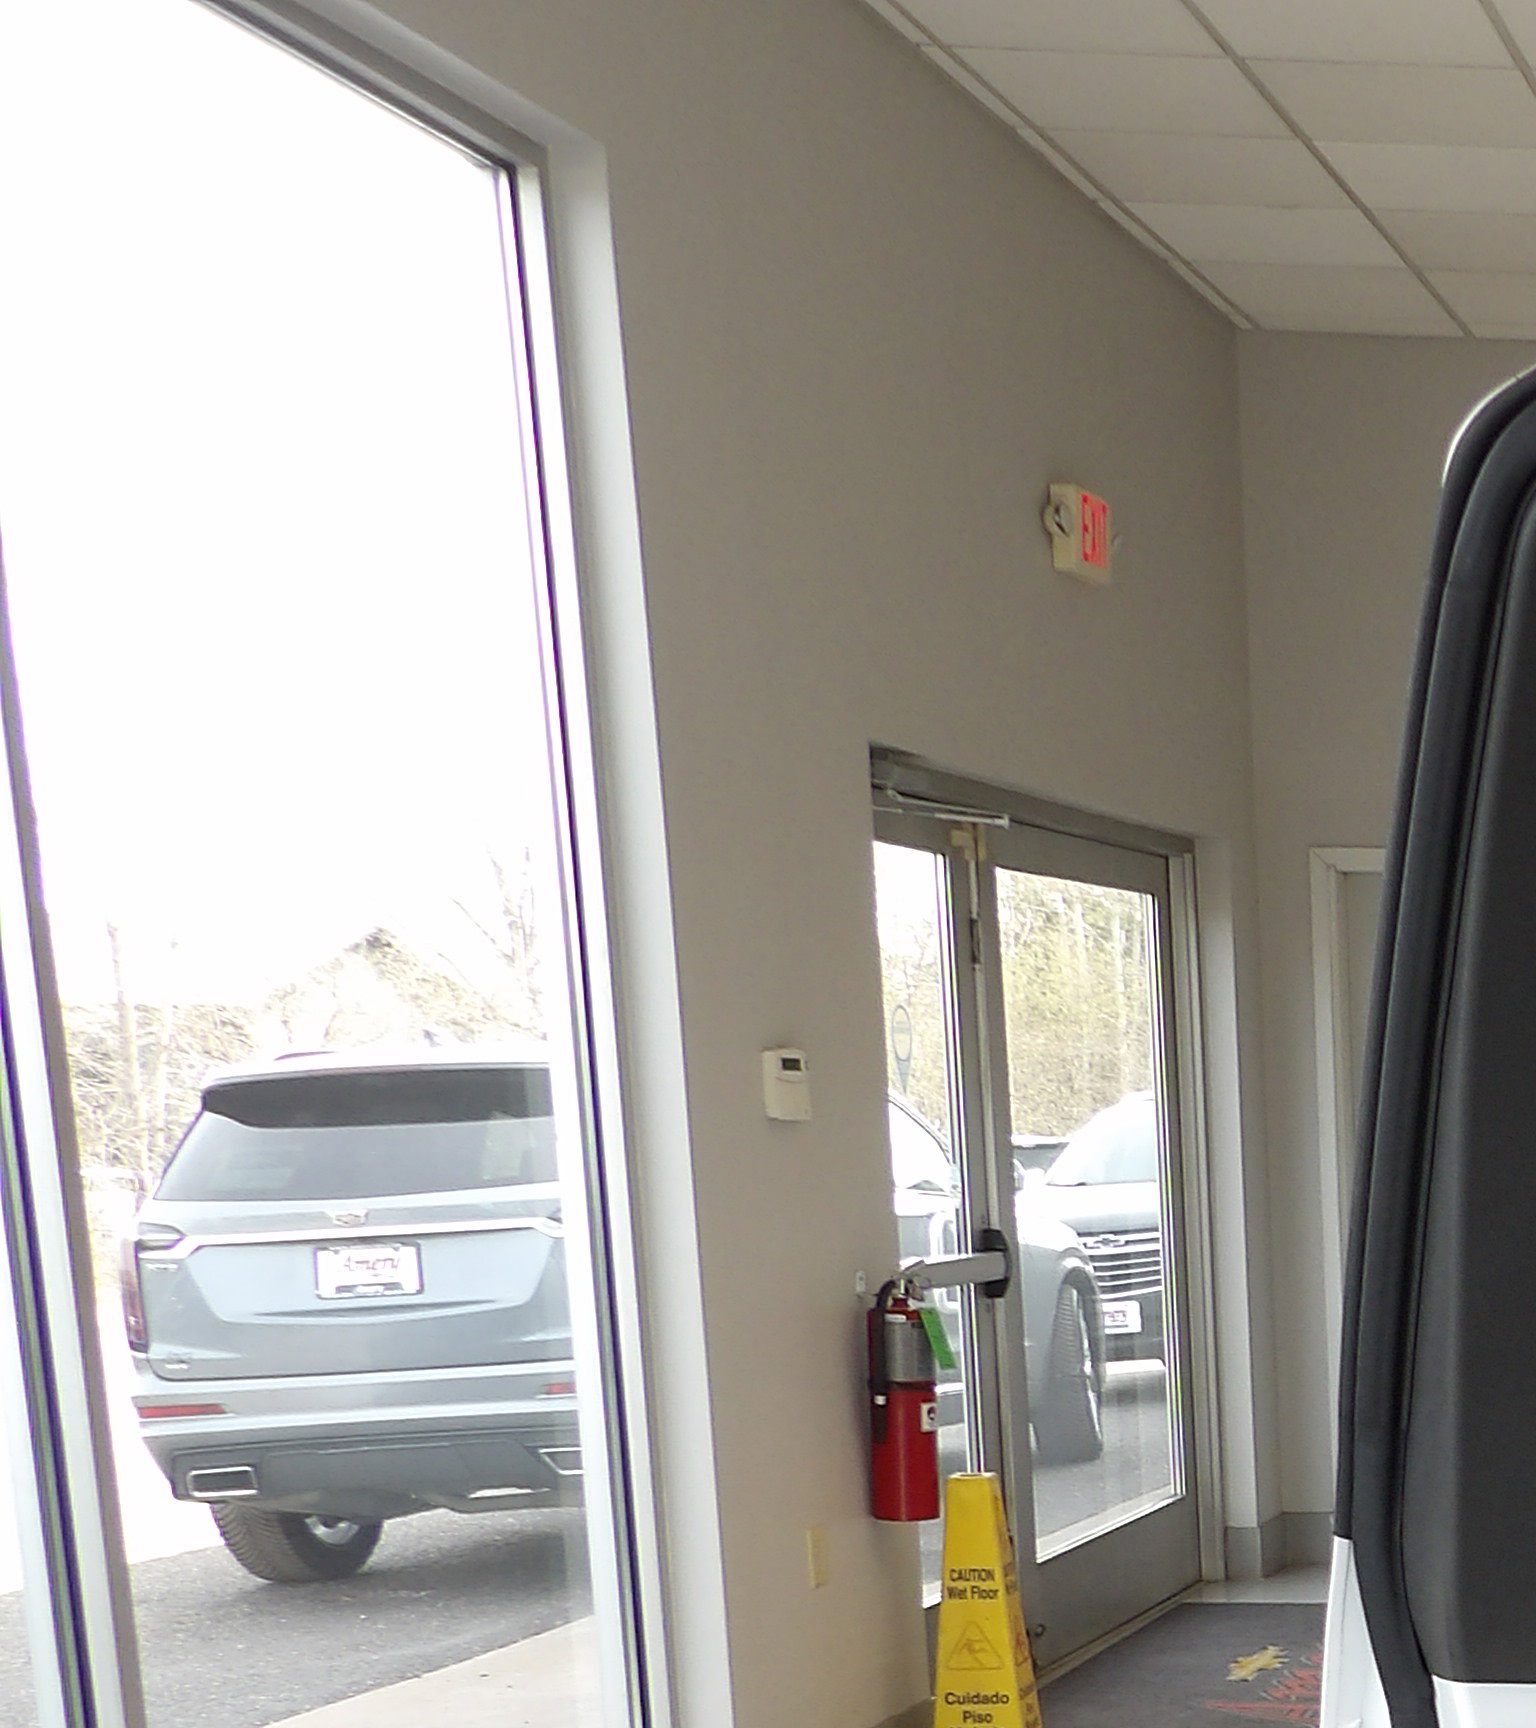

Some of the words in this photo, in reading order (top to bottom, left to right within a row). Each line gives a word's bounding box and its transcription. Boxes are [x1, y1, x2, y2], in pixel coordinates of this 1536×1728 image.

[949, 1568, 996, 1582] CAUTION
[947, 1586, 968, 1600] Wet
[971, 1585, 999, 1600] Floor
[944, 1692, 1010, 1705] Cuidado
[963, 1710, 993, 1723] Piso
